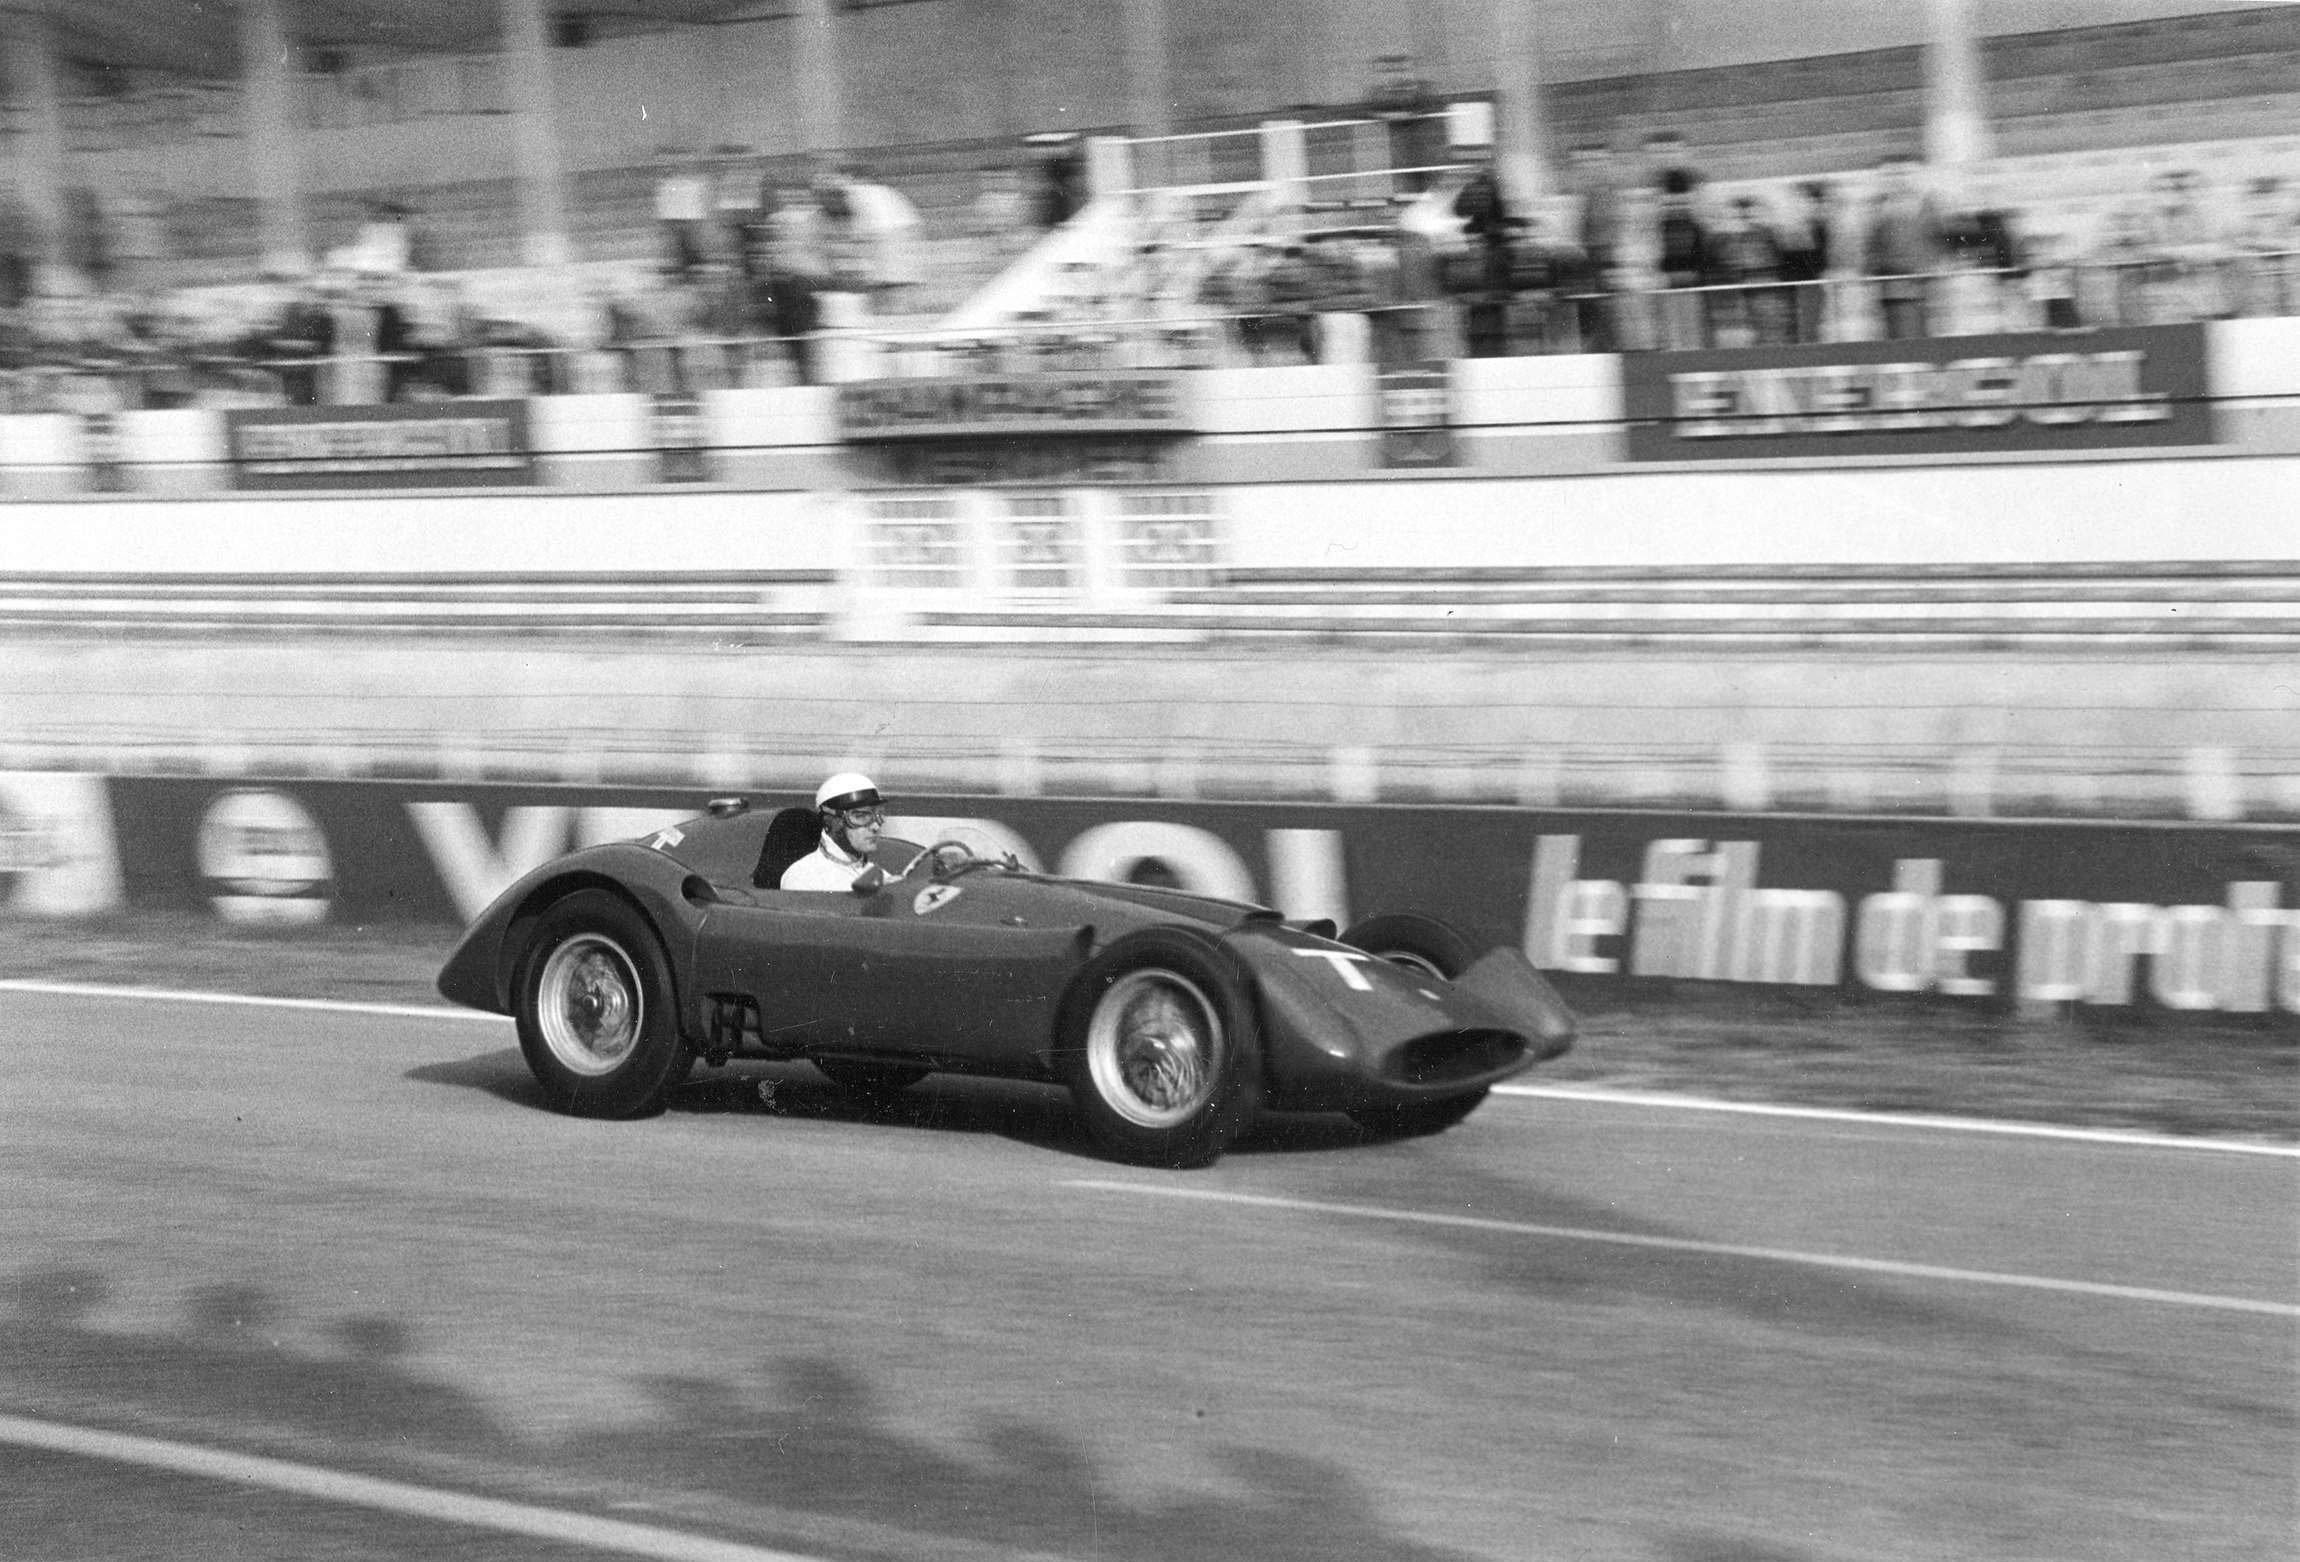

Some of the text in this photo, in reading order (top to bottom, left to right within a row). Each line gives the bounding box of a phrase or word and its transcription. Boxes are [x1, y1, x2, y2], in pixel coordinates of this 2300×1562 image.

[1525, 833, 2300, 1022] le film de prot
